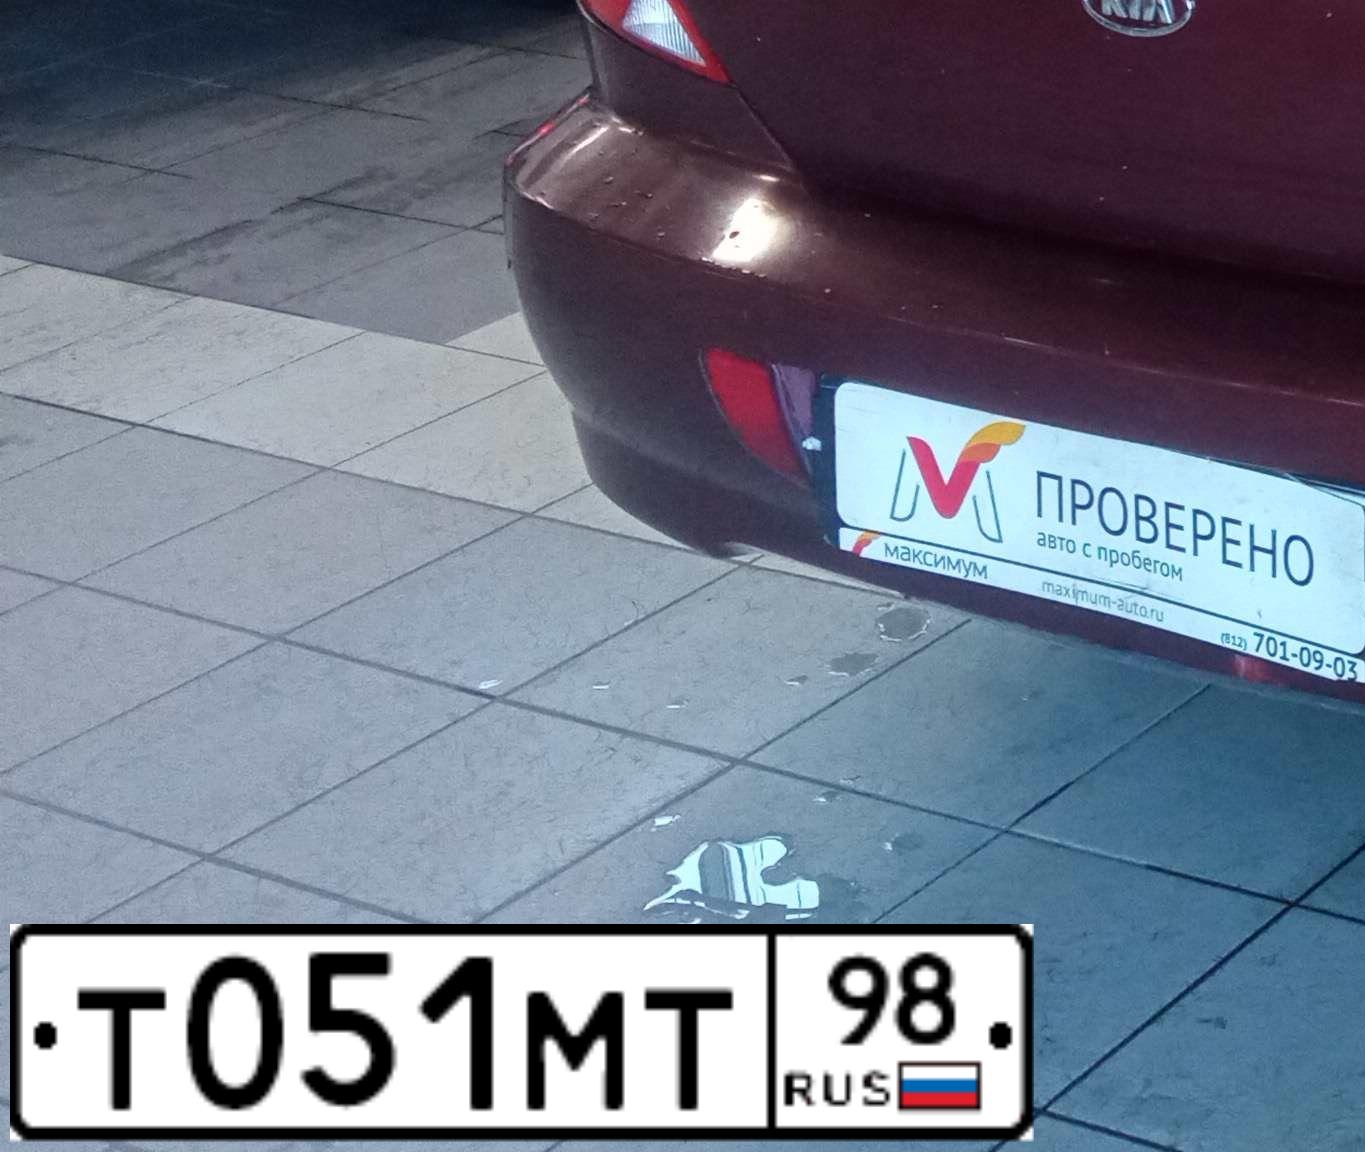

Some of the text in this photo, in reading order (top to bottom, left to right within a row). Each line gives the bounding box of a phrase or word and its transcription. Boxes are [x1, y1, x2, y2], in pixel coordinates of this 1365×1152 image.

[1035, 469, 1315, 587] ПРОВЕРЕНО
[883, 541, 989, 580] максимум
[1036, 530, 1184, 582] авто с пробегом
[1041, 580, 1165, 623] maximum-auto.ru
[1220, 631, 1358, 683] (812) 701-09-03
